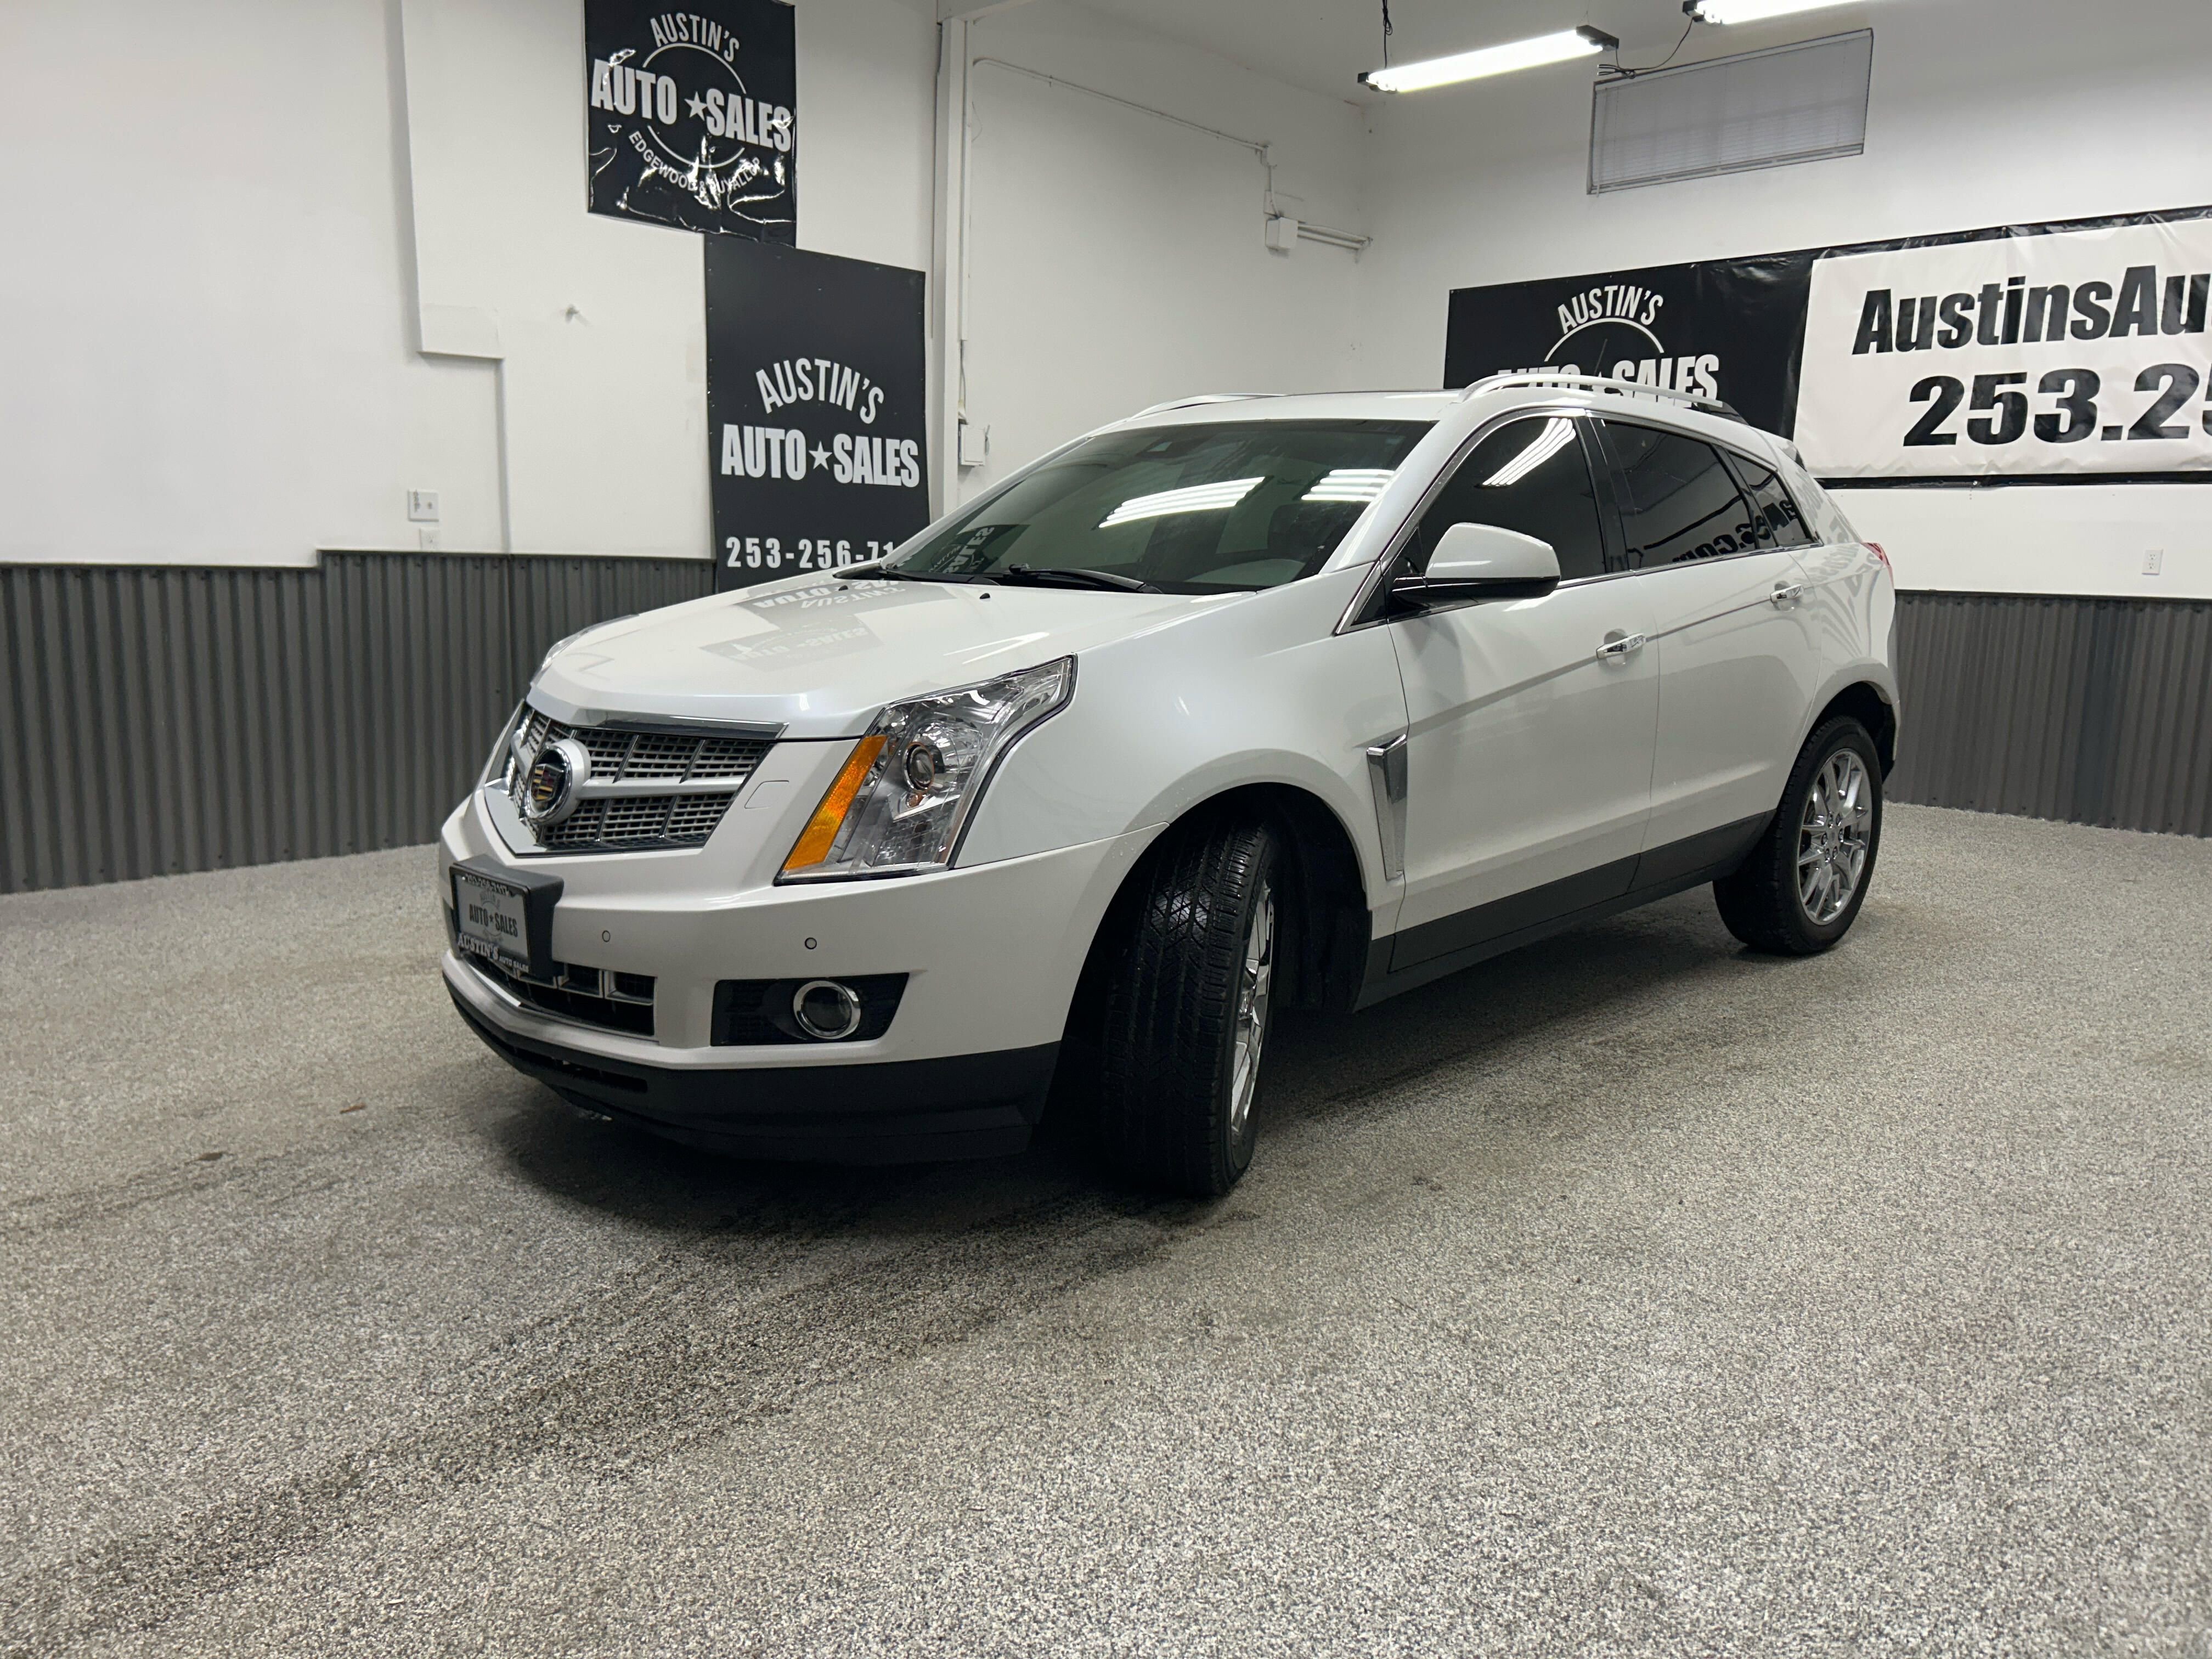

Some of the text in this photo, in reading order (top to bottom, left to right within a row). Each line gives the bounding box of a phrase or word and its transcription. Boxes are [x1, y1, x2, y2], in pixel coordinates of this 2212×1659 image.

[650, 13, 740, 62] AUSTIN'S
[591, 58, 792, 152] AUTO SALES
[707, 157, 760, 194] UYALLUP
[1558, 285, 1663, 334] AUSTIN'S
[755, 358, 884, 424] AUSTIN'S
[1612, 354, 1719, 407] SALES
[721, 424, 919, 488] AUTO SALES
[469, 904, 488, 927] AUTO
[494, 912, 518, 938] SALES
[458, 932, 499, 961] AUSTIN'S
[499, 956, 512, 966] AUTO
